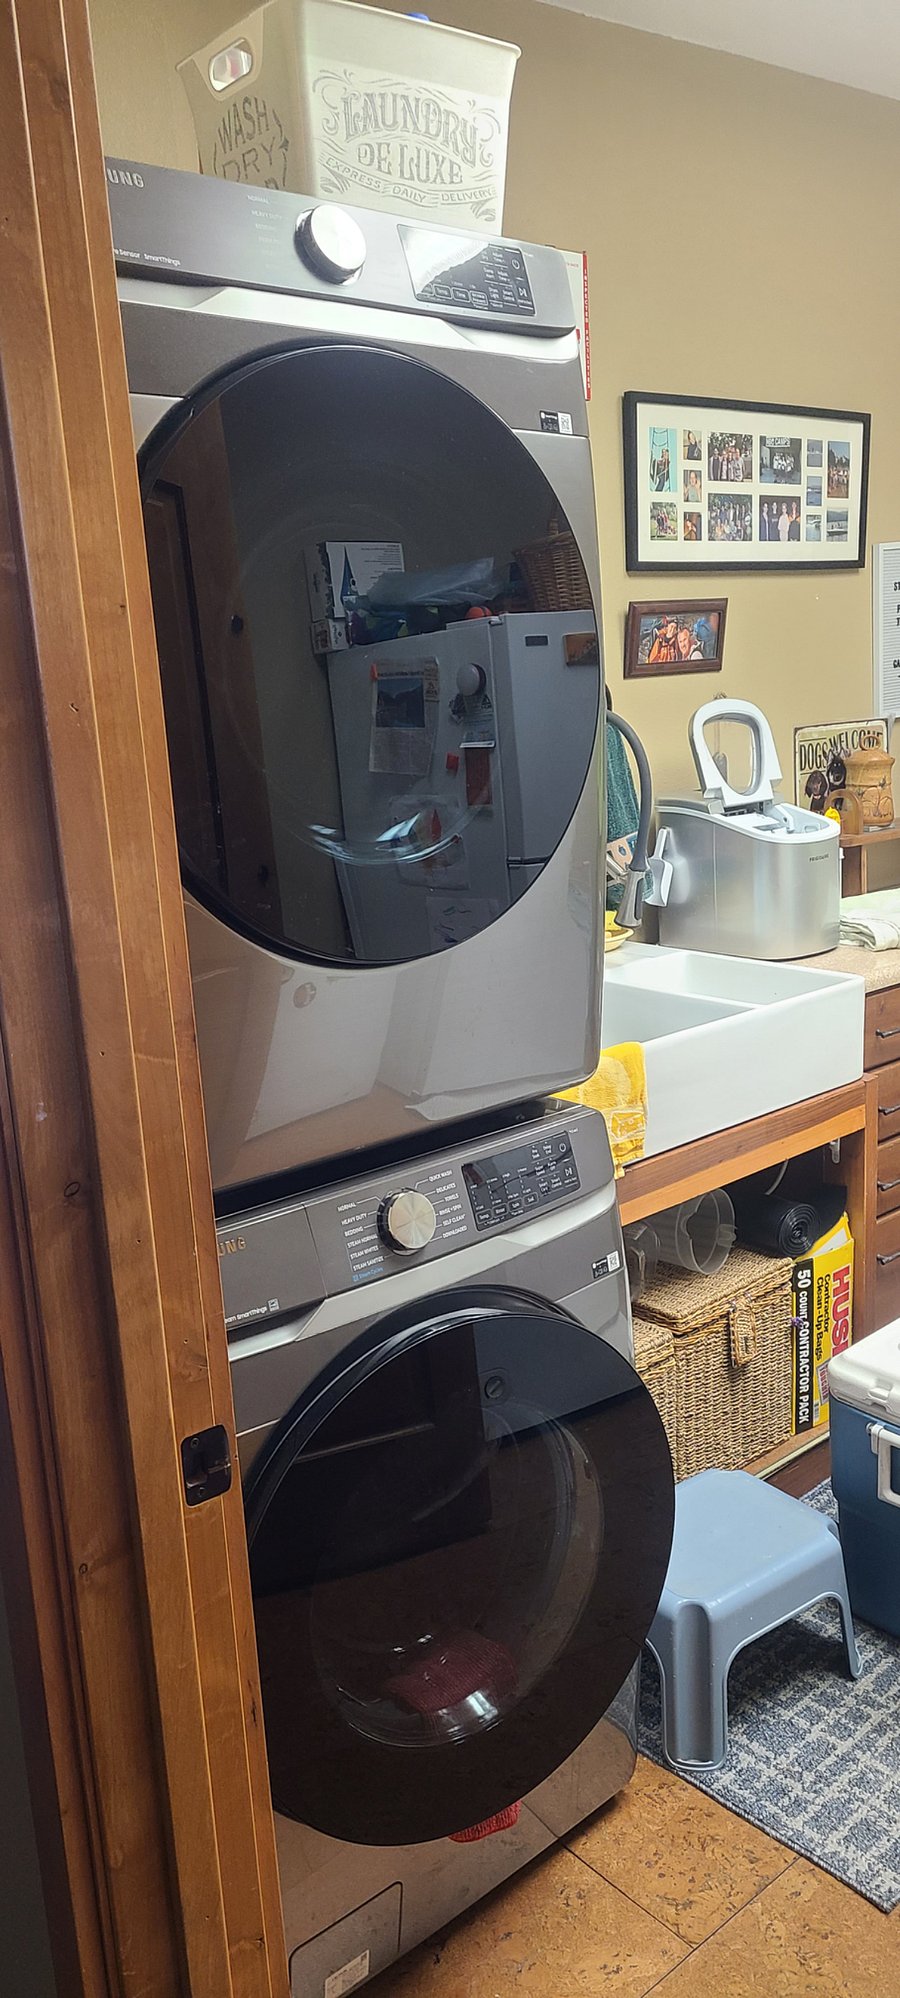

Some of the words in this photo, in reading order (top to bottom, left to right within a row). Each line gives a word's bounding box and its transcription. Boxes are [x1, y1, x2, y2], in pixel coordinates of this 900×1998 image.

[218, 96, 270, 154] WASH
[341, 90, 478, 168] LAUNDRY
[222, 136, 276, 183] DRY
[358, 142, 392, 175] DE
[399, 143, 463, 185] LUXE
[107, 168, 145, 188] UNG
[325, 157, 382, 189] EXPRESS
[392, 185, 426, 203] DAILY
[441, 188, 492, 202] DELIVERY
[800, 741, 828, 771] DOGS
[341, 1217, 355, 1226] HEAVY
[355, 1213, 367, 1221] DUTY
[218, 1236, 246, 1256] UNG
[797, 1269, 812, 1289] 50
[799, 1290, 808, 1319] COUNT
[815, 1276, 824, 1331] Clean-Up
[798, 1321, 810, 1394] CONTRACTOR
[815, 1331, 824, 1361] Bags
[798, 1394, 810, 1424] PACK
